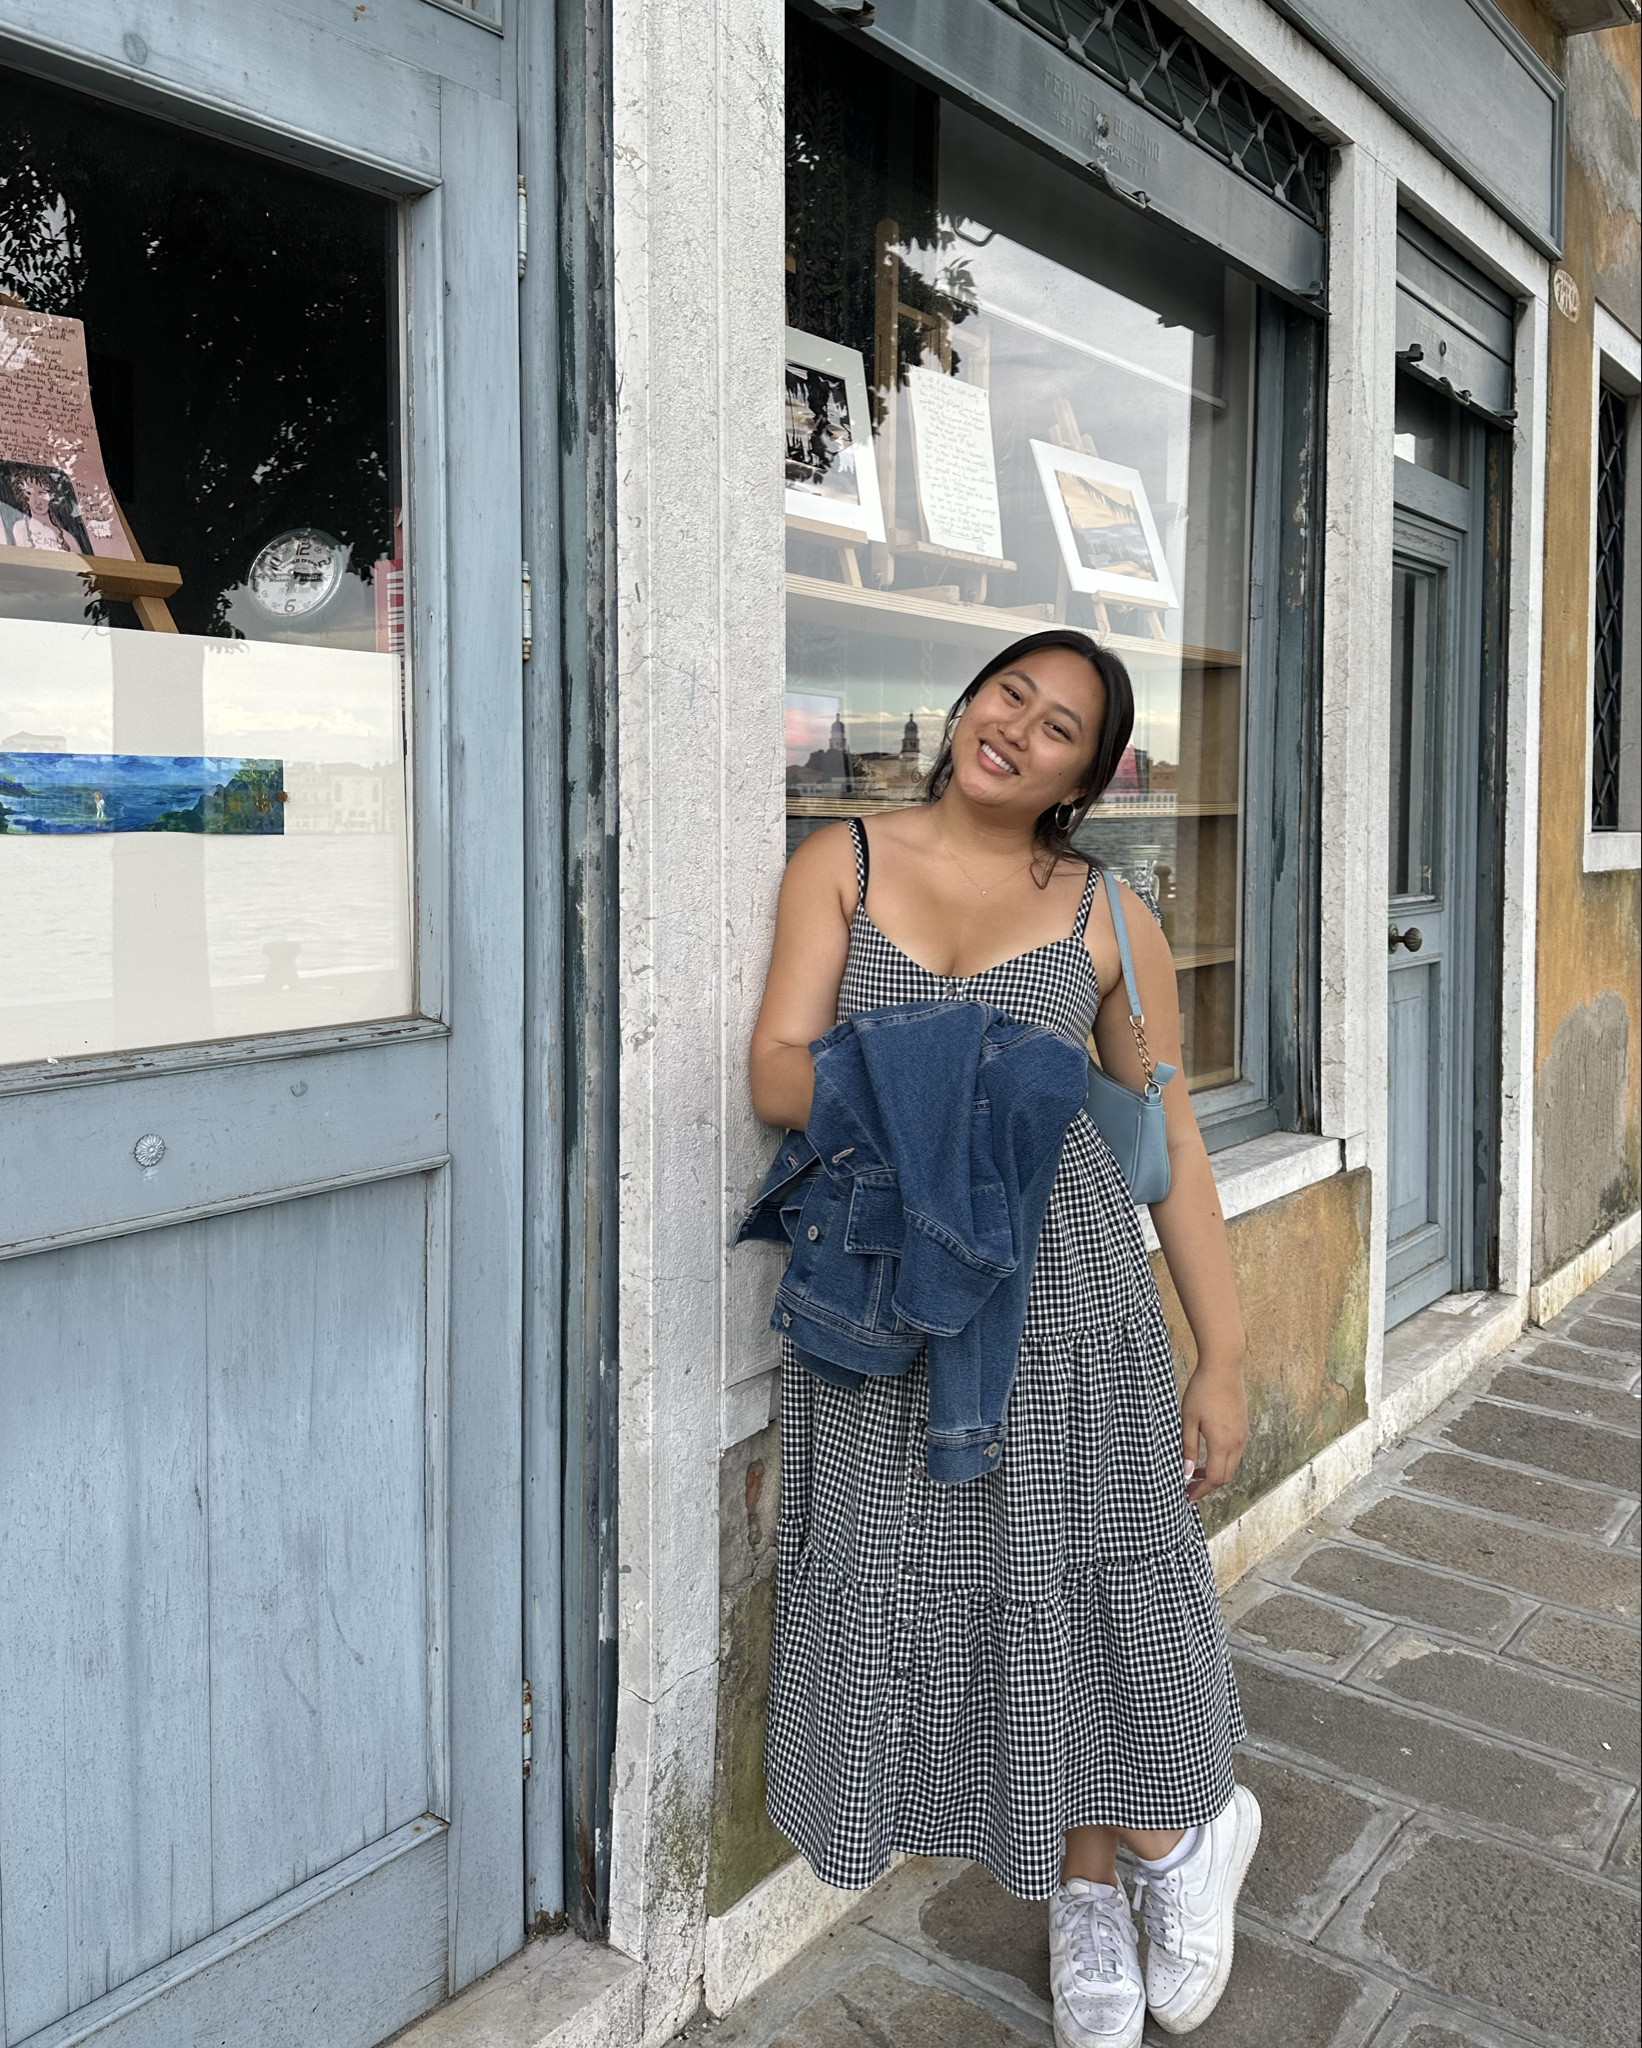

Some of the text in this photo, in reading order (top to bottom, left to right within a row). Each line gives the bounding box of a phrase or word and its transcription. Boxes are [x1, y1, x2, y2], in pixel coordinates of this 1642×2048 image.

[1043, 67, 1160, 162] FERVET BERGAMO
[296, 541, 312, 556] 12
[284, 598, 297, 613] 6
